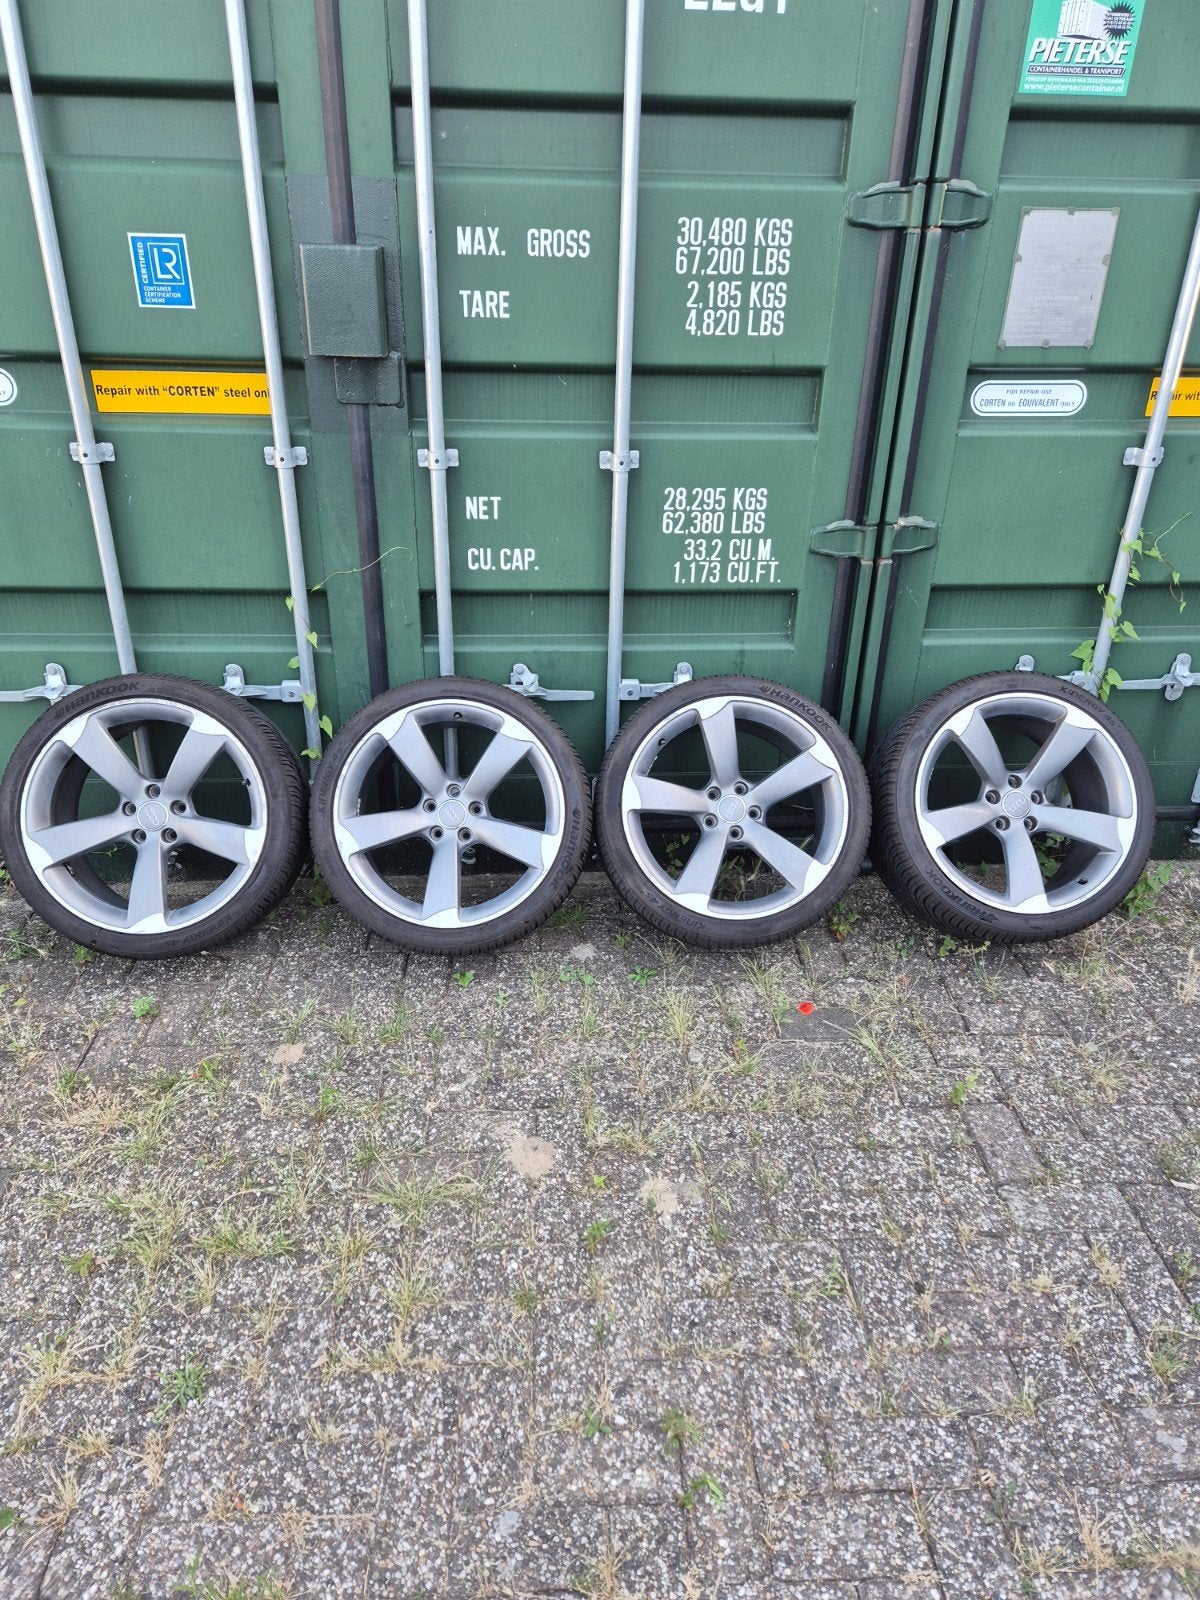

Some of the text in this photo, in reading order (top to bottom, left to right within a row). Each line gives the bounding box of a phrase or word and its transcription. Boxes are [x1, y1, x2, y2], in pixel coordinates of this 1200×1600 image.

[1028, 38, 1132, 65] PIETERSE
[1029, 65, 1083, 74] CONTAINERHANDEL
[1090, 67, 1123, 75] TRANSPORT
[1023, 83, 1124, 93] www.pietersecontainer.nl
[456, 226, 591, 258] MAX. GROSS
[677, 216, 793, 247] 30,480 KGS
[137, 241, 148, 284] CERTIFIED
[153, 247, 181, 279] LR
[675, 246, 791, 276] 67,200 LBS
[458, 290, 510, 319] TARE
[686, 280, 787, 309] 2,185 KGS
[685, 308, 785, 337] 4,820 LBS
[95, 384, 132, 398] Repair
[135, 385, 160, 396] with
[223, 387, 251, 398] steel
[254, 387, 270, 398] onl
[979, 398, 1007, 407] CORTEN
[1018, 398, 1060, 407] EQUIVALENT
[465, 496, 501, 520] NET
[663, 486, 768, 511] 28,295 KGS
[662, 511, 766, 535] 62,380 LBS
[683, 538, 723, 561] 33.2
[673, 561, 721, 584] 1,173
